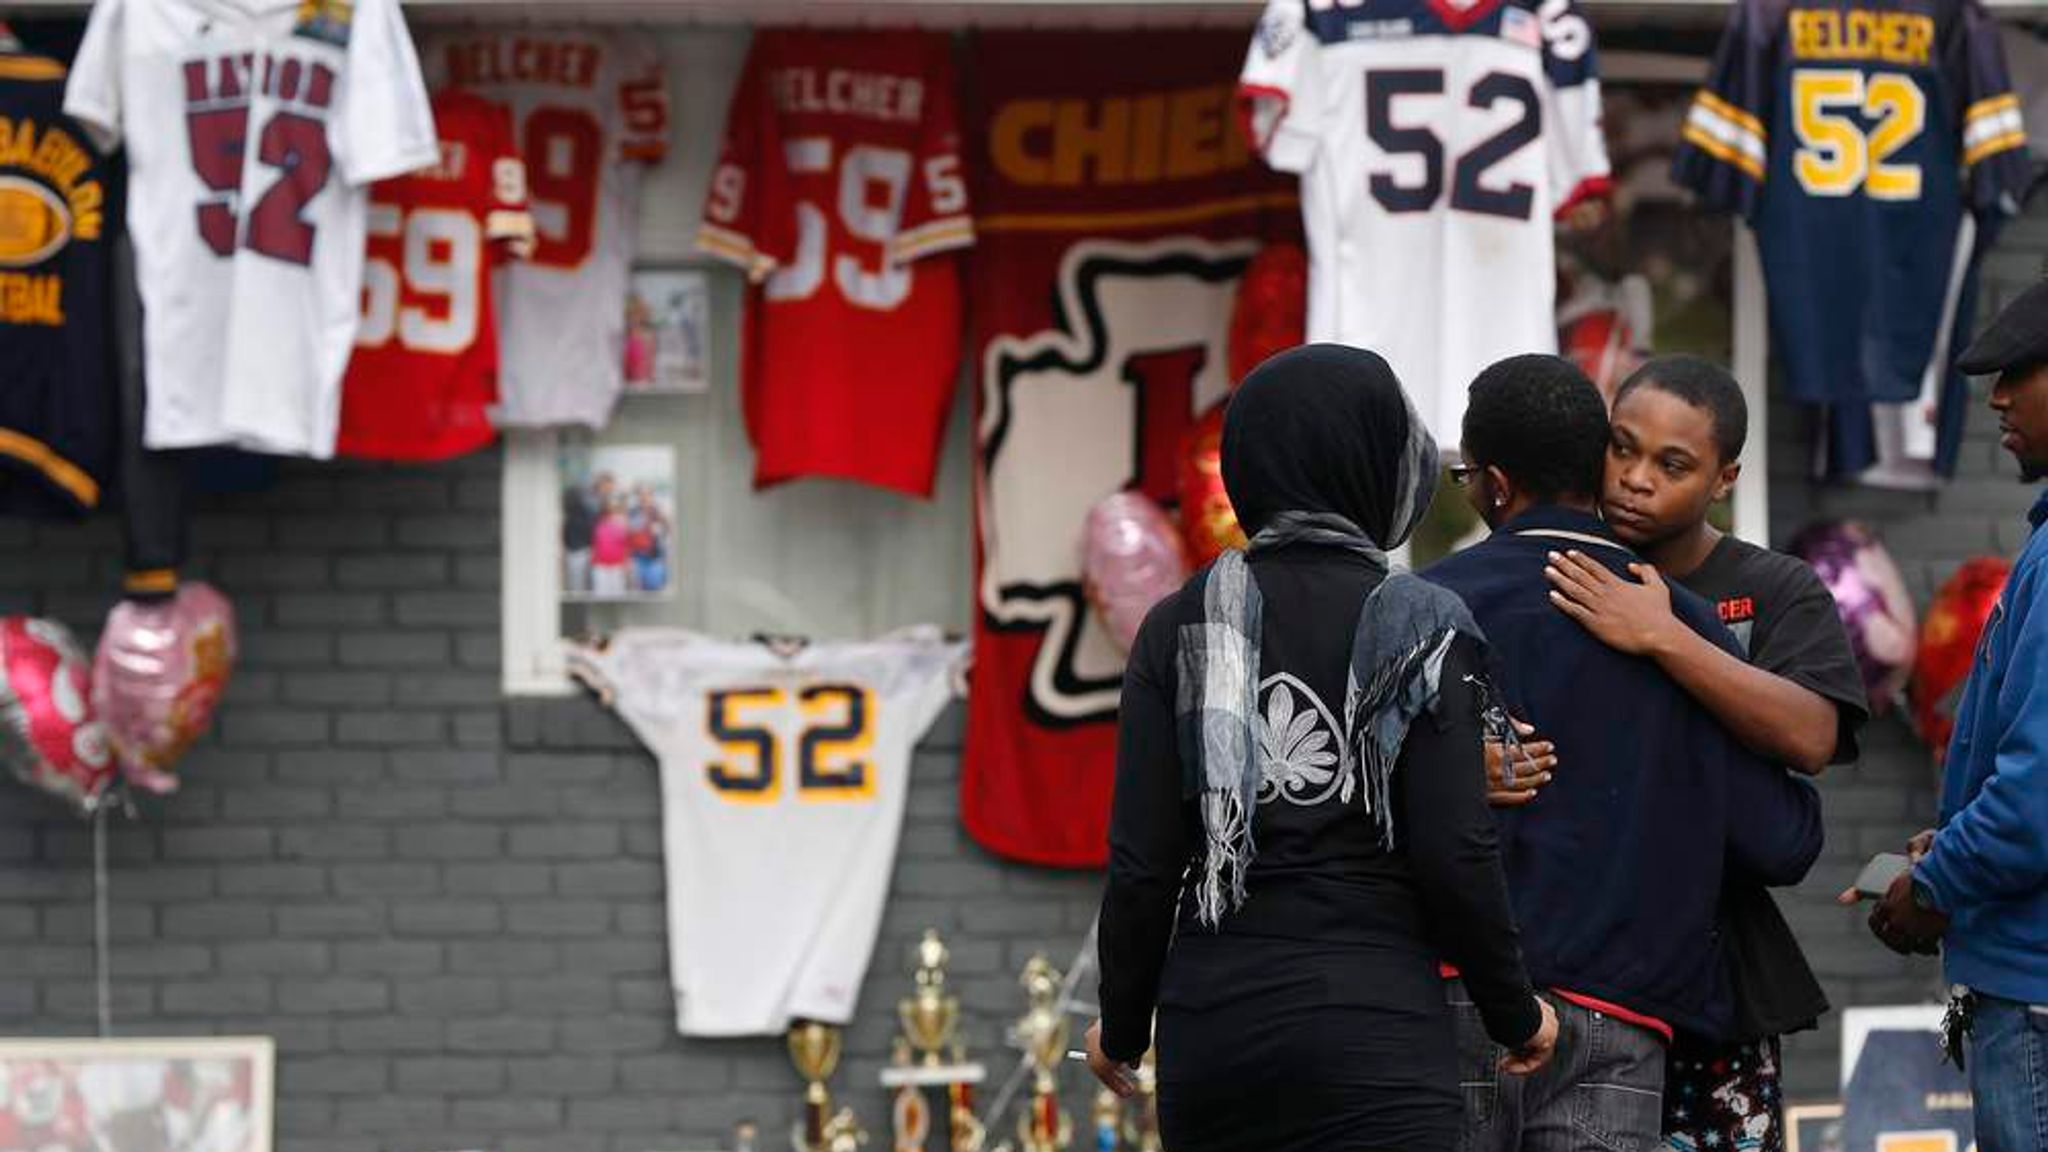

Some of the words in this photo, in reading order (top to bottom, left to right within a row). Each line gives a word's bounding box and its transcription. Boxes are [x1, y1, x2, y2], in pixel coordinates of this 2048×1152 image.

[186, 105, 332, 267] 52
[924, 155, 969, 214] 5
[1364, 68, 1542, 221] 52
[1790, 68, 1927, 201] 52
[765, 137, 912, 310] 59
[705, 683, 876, 806] 52
